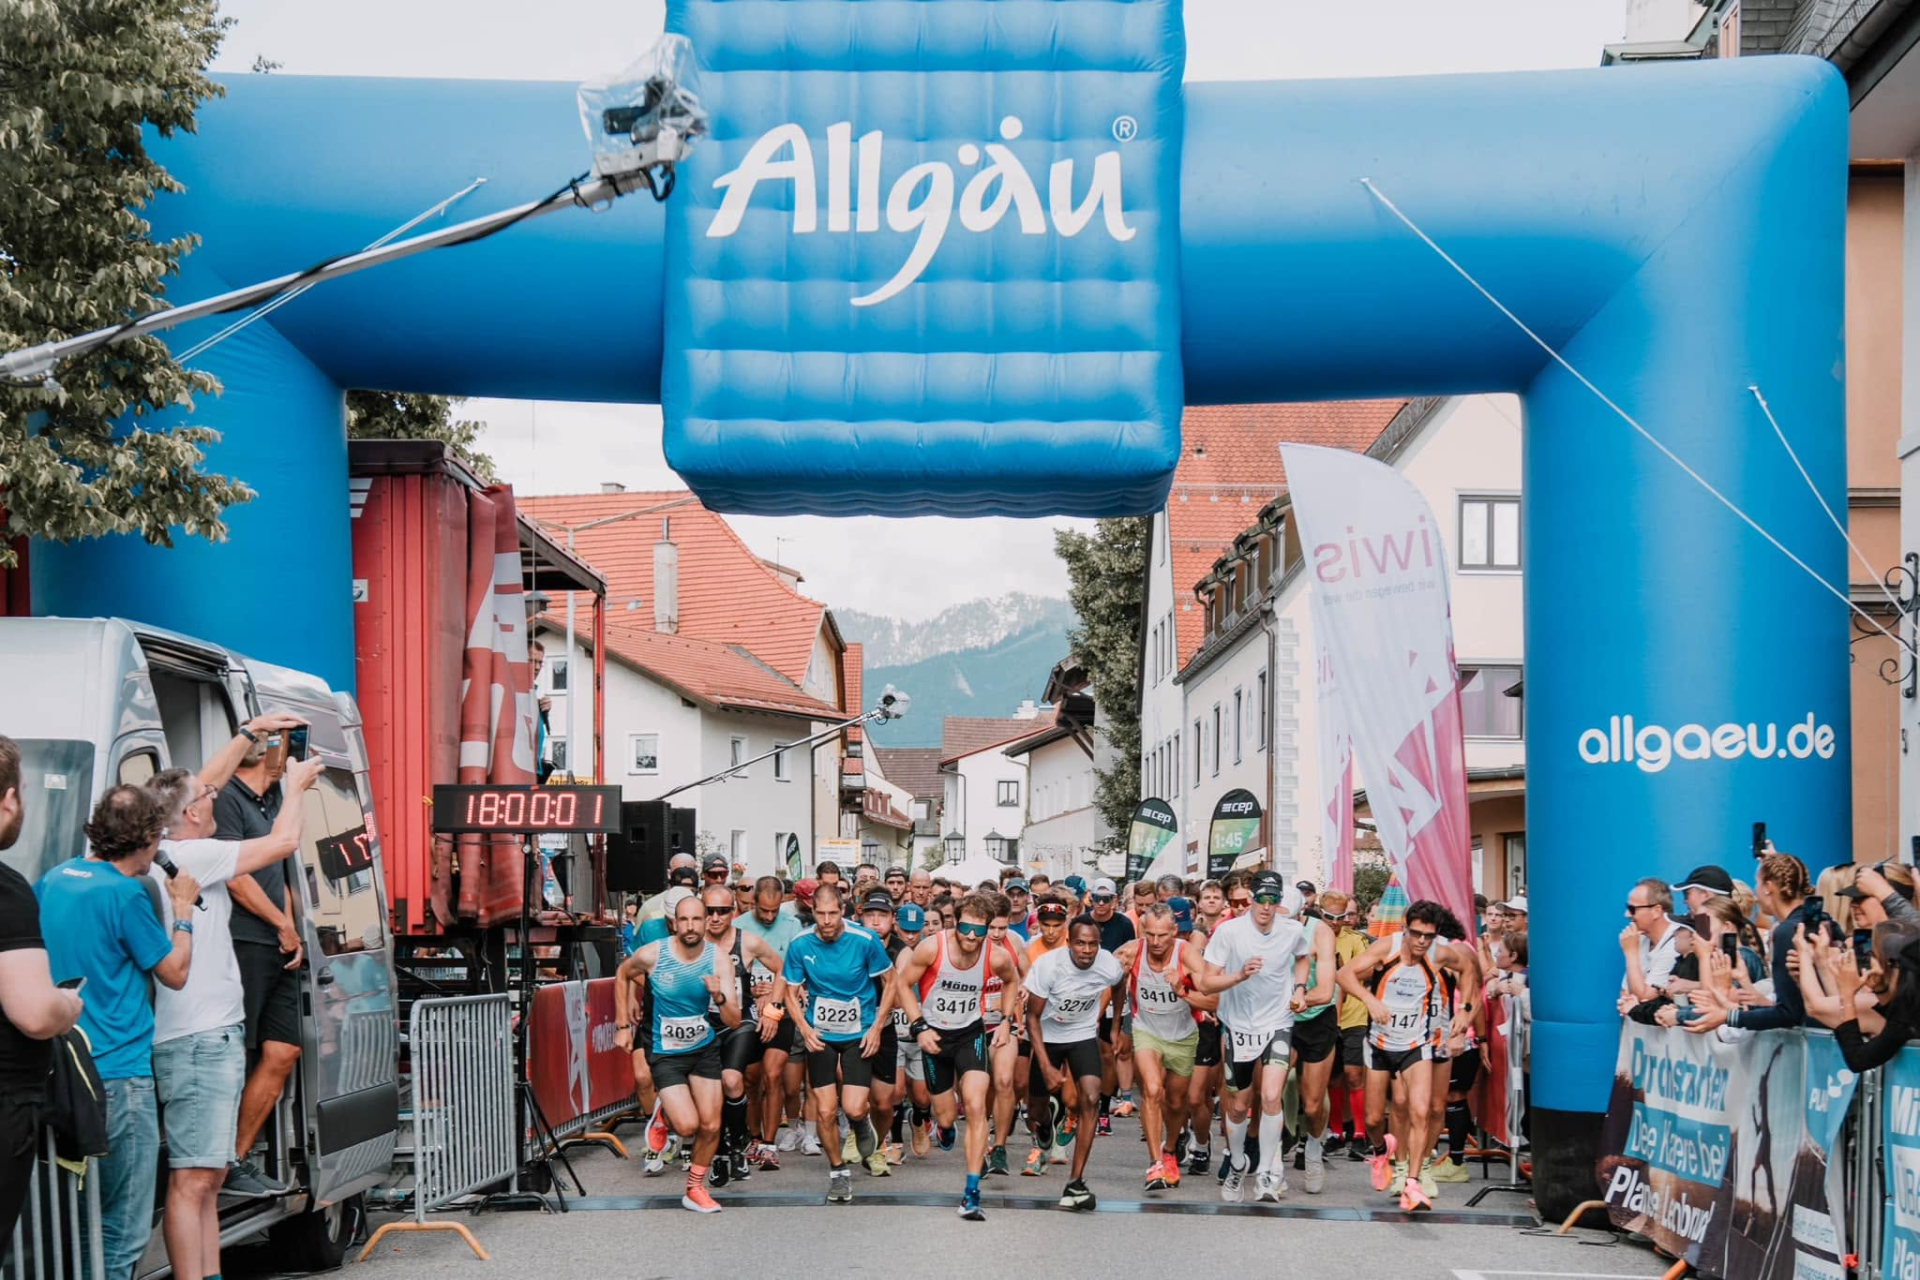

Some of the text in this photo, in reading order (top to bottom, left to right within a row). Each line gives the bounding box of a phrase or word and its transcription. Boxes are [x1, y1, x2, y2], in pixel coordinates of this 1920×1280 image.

[705, 116, 1137, 307] Allgäu
[1578, 712, 1836, 773] allgaeu.de
[466, 793, 603, 826] 18:00:01
[1151, 809, 1172, 825] cep
[1231, 801, 1253, 815] cep
[1214, 831, 1243, 849] 1:45
[1140, 987, 1178, 1003] 3410
[817, 1006, 858, 1023] 3223
[936, 997, 977, 1015] 3416
[1698, 1130, 1726, 1181] bei
